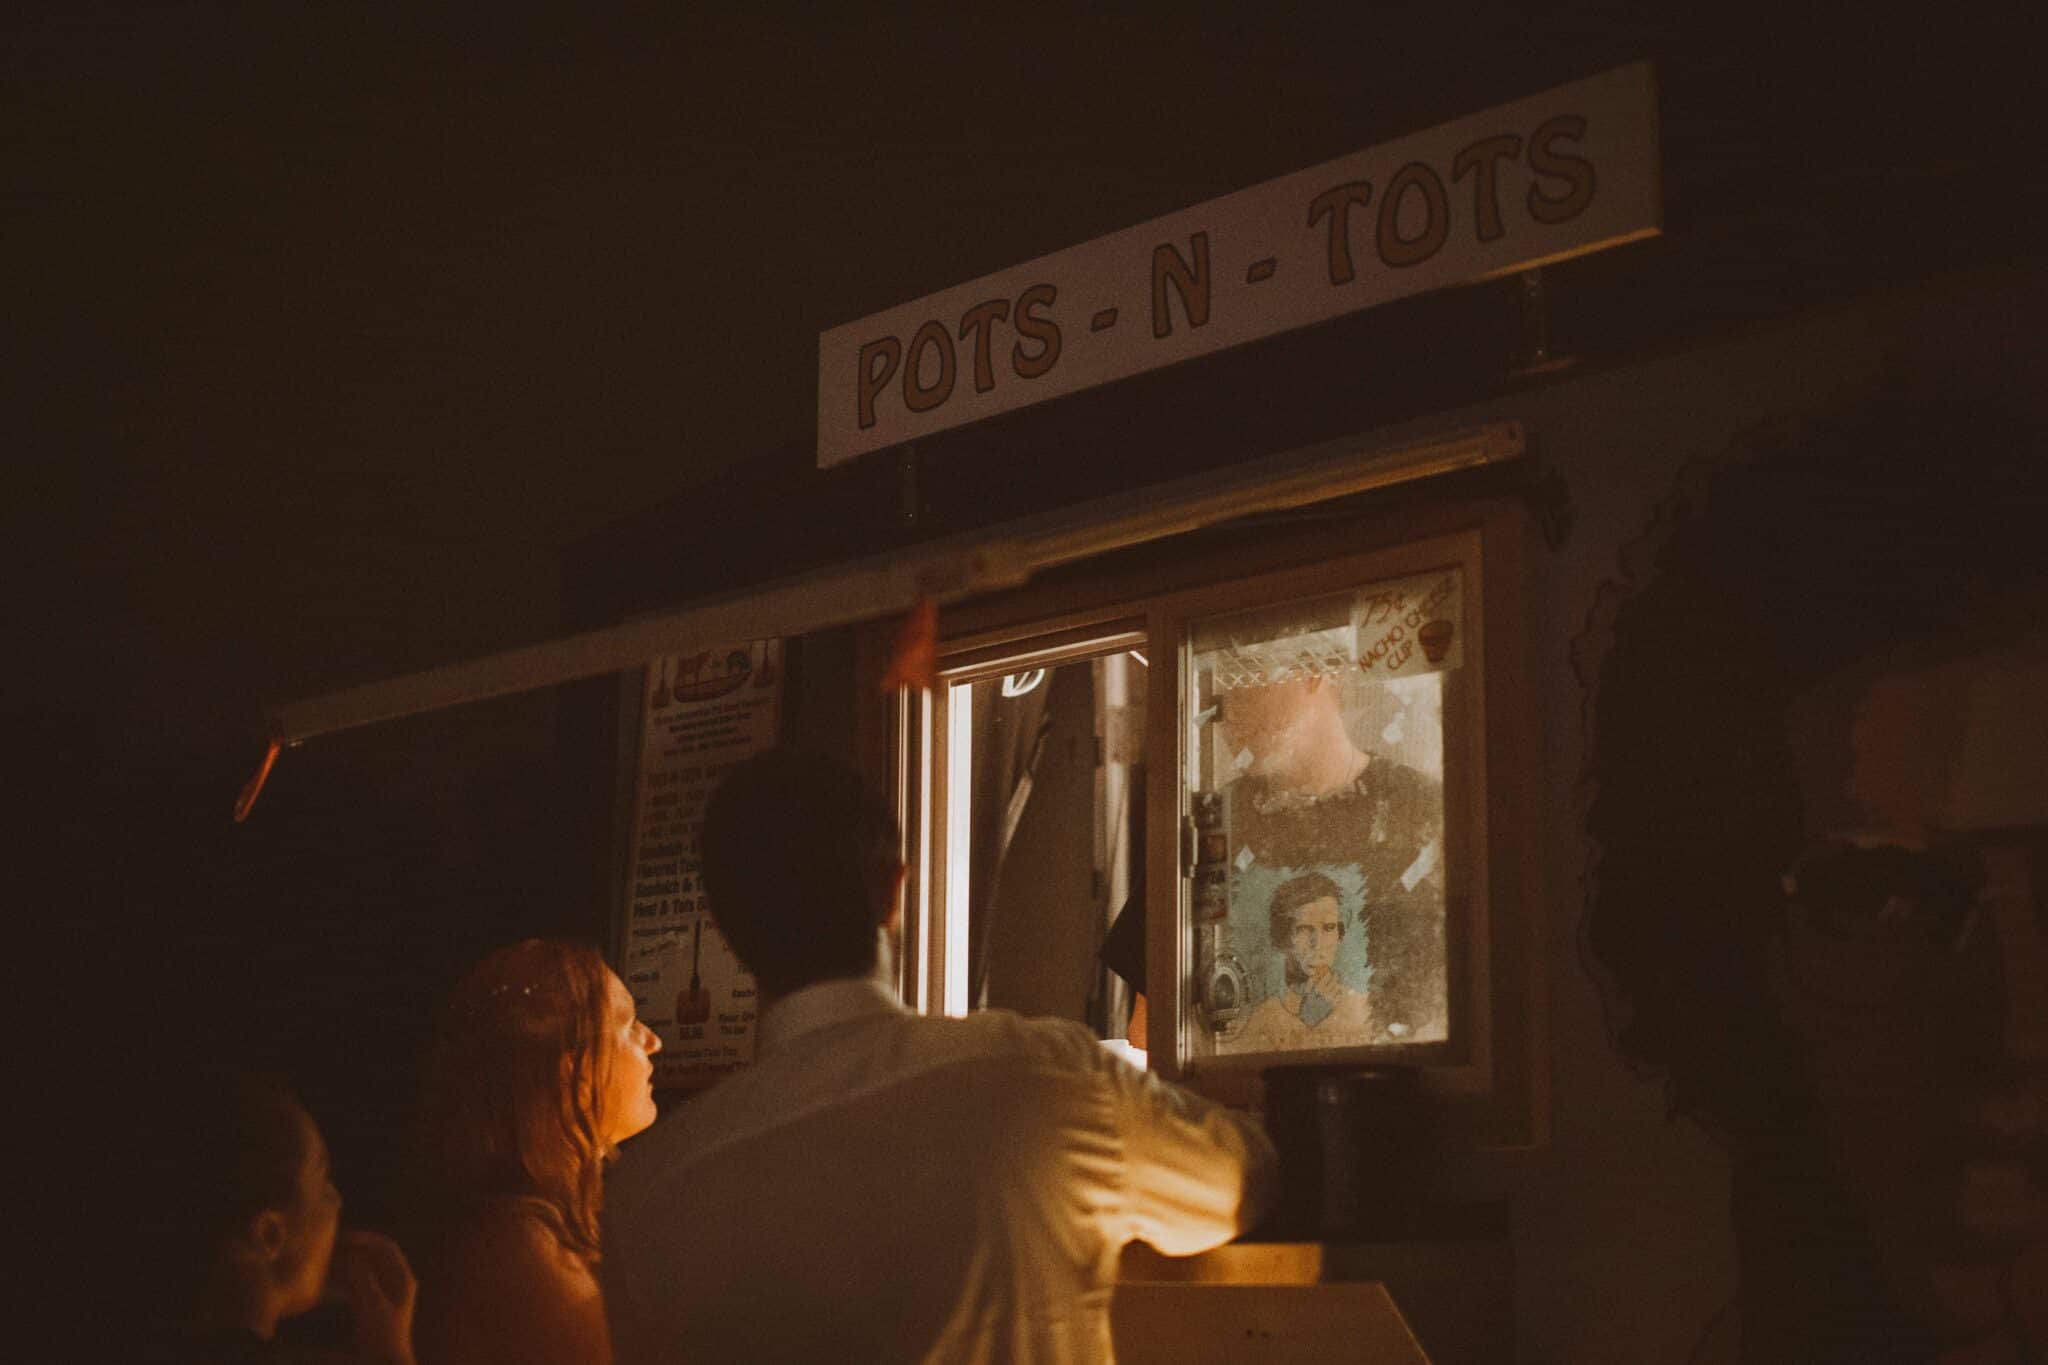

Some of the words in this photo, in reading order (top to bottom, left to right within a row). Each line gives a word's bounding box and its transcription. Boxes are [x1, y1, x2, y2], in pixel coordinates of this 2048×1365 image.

[856, 284, 1062, 429] POTS
[1151, 231, 1211, 338] N
[1308, 115, 1597, 286] TOTS
[1359, 626, 1404, 673] NACHO
